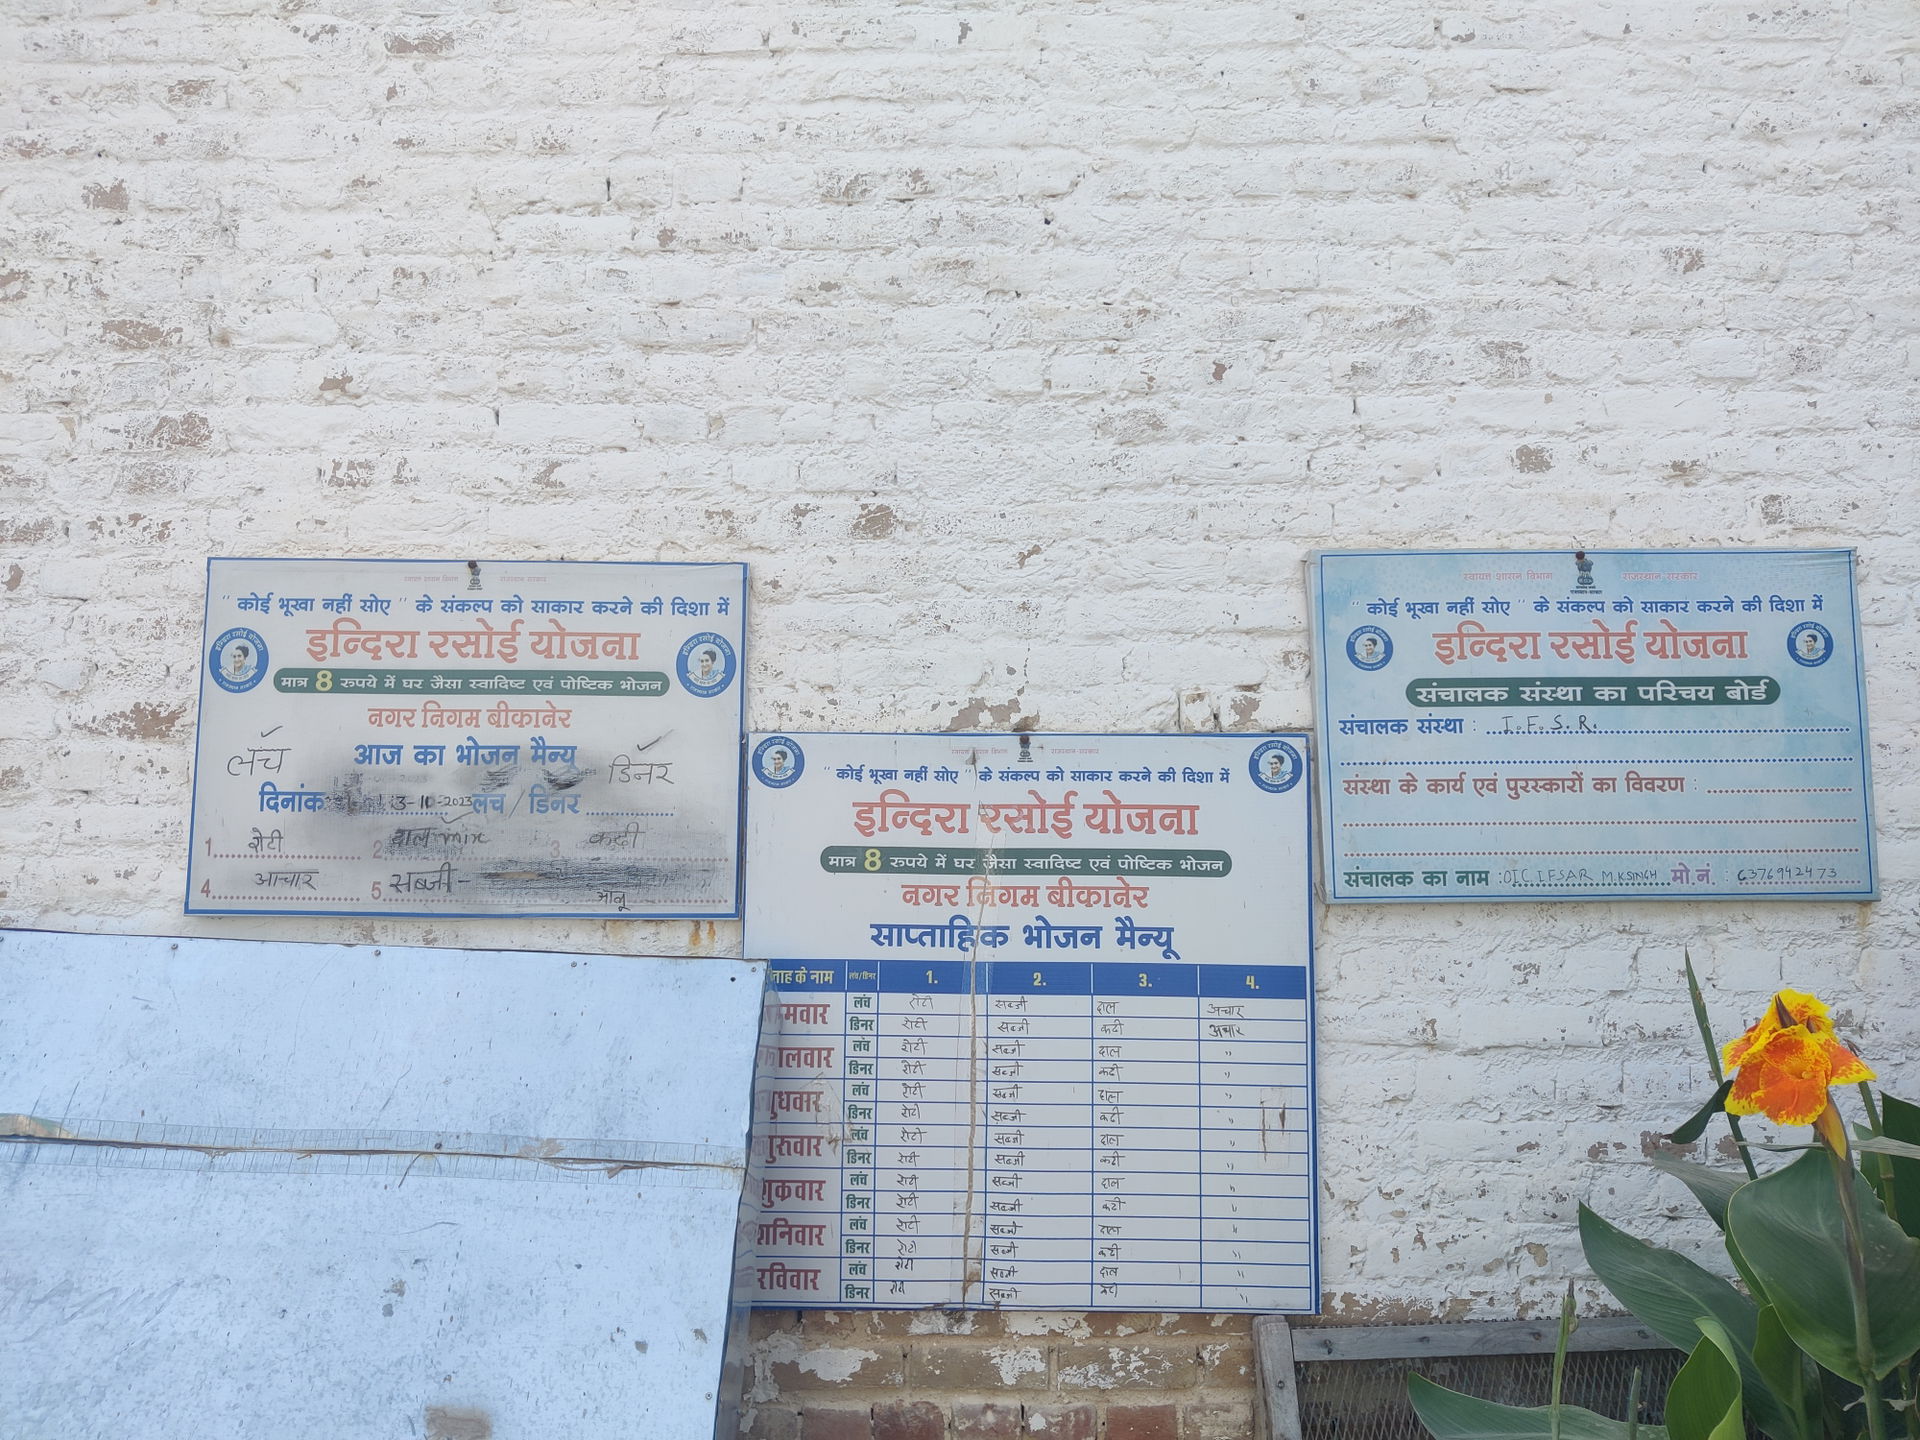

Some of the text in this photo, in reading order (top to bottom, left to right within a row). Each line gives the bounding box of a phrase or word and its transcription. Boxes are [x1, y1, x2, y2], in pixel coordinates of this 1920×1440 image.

[237, 592, 730, 616] कोई भूखा नहीं सोए के संकल्प को साकार करने की दिशा में
[1367, 594, 1823, 619] कोई भूखा नहीं सोए के संकल्प को साकार करने की दिशा में
[306, 617, 641, 663] इन्दिरा रसोई योजना
[1432, 619, 1748, 665] इन्दिरा रसोई योजना
[281, 677, 309, 688] मात्र
[315, 670, 333, 692] 8
[340, 674, 377, 689] रुपये
[384, 674, 396, 689] में
[402, 679, 424, 690] घर
[431, 675, 462, 689] जैसा
[469, 675, 525, 689] स्वादिष्ट
[532, 676, 554, 692] एवं
[620, 677, 662, 692] भोजन
[1416, 679, 1769, 703] संचालक संस्था का परिचय बोर्ड
[368, 700, 572, 728] नगर निगम बीकानेर
[1339, 713, 1464, 735] संचालक संस्था
[354, 743, 403, 766] आज
[413, 744, 446, 766] का
[456, 736, 520, 766] भोजन
[609, 754, 674, 784] डिनर
[836, 764, 1230, 784] कोई भूखा नहीं सोए के संकल्प को साकार करने की दिशा में
[1343, 770, 1685, 800] संस्था के कार्य एवं पुरस्कारों का विवरण
[259, 782, 326, 813] दिनांक
[852, 789, 1200, 839] इन्दिरा रसोई योजना
[829, 856, 856, 867] मात्र
[864, 849, 882, 871] 8
[890, 854, 928, 869] रुपये
[935, 854, 947, 868] में
[954, 858, 975, 869] घर
[983, 855, 1016, 869] जैसा
[1024, 855, 1082, 870] स्वादिष्ट
[1089, 856, 1111, 872] एवं
[1180, 856, 1223, 872] भोजन
[1343, 866, 1490, 887] संचालक का नाम
[901, 876, 1149, 909] नगर निगम बीकानेर
[870, 915, 1181, 960] साप्ताहिक भोजन मैन्यू
[795, 967, 834, 984] के नाम
[853, 994, 872, 1009] लंच
[850, 1016, 875, 1031] डिनर
[852, 1037, 871, 1052] लंच
[849, 1060, 874, 1075] डिनर
[852, 1081, 870, 1096] लंच
[848, 1104, 872, 1119] डिनर
[851, 1126, 869, 1140] लंच
[847, 1149, 872, 1164] डिनर
[850, 1171, 868, 1185] लंच
[846, 1194, 871, 1209] डिनर
[849, 1216, 868, 1230] लंच
[845, 1239, 871, 1254] डिनर
[757, 1262, 821, 1291] रविवार
[849, 1261, 867, 1275] लंच
[845, 1284, 870, 1299] डिनर
